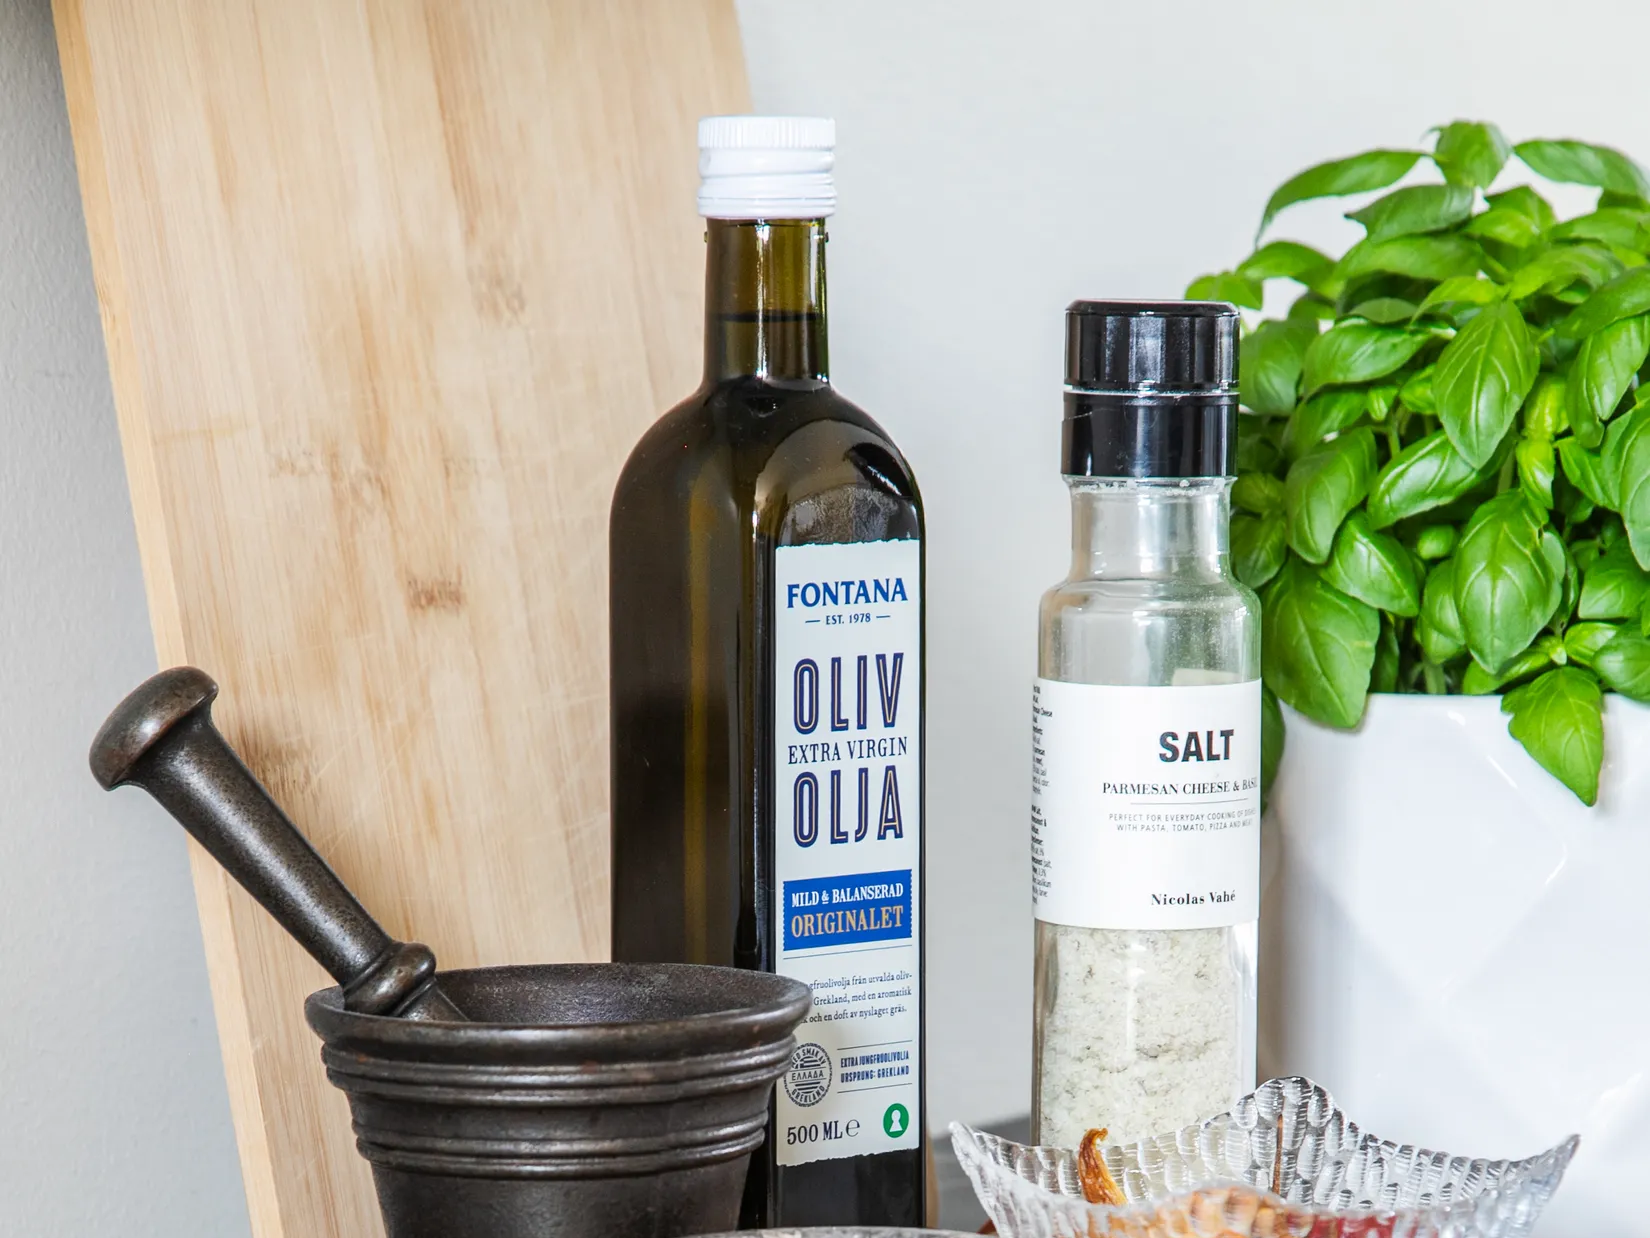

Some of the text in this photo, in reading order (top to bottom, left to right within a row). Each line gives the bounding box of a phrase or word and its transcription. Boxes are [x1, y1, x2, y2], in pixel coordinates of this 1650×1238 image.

[786, 577, 908, 608] FONTANA
[825, 612, 871, 625] EST. 1978
[793, 652, 904, 735] OLIV
[787, 736, 908, 765] EXTRA VIRGIN
[1158, 729, 1235, 763] SALT
[1102, 782, 1179, 795] PARMESAN
[1182, 781, 1230, 795] CHEESE
[1232, 780, 1240, 792] &
[793, 765, 904, 848] OLJA
[1108, 813, 1143, 822] PERFECT
[1146, 814, 1161, 822] FOR
[1165, 813, 1205, 822] EVERYDAY
[1207, 810, 1236, 821] COOKING
[1116, 823, 1138, 832] WITH
[1140, 824, 1169, 833] PASTA,
[1172, 823, 1207, 832] TOMATO,
[1209, 821, 1228, 831] PIZZA
[1229, 819, 1241, 828] AND
[791, 882, 904, 908] MILD & BALANSERAD
[1151, 889, 1236, 906] Nicolas Vahé
[791, 905, 904, 938] ORIGINALET
[807, 976, 850, 992] gfruolivolja
[868, 971, 895, 984] utvalda
[813, 985, 912, 1006] Grekland, med en aromatisk
[809, 1012, 823, 1023] och
[823, 1013, 833, 1022] en
[833, 1009, 849, 1020] doft
[849, 1010, 858, 1018] av
[858, 1005, 889, 1019] nyslaget
[801, 1047, 820, 1059] SMAK
[840, 1050, 910, 1068] EXTRA JUNGFRUOLIVOLJA
[840, 1065, 910, 1083] URSPRUNG: GREKLAND
[790, 1084, 826, 1103] GREKLAND
[786, 1124, 819, 1146] 500
[822, 1120, 843, 1141] ML
